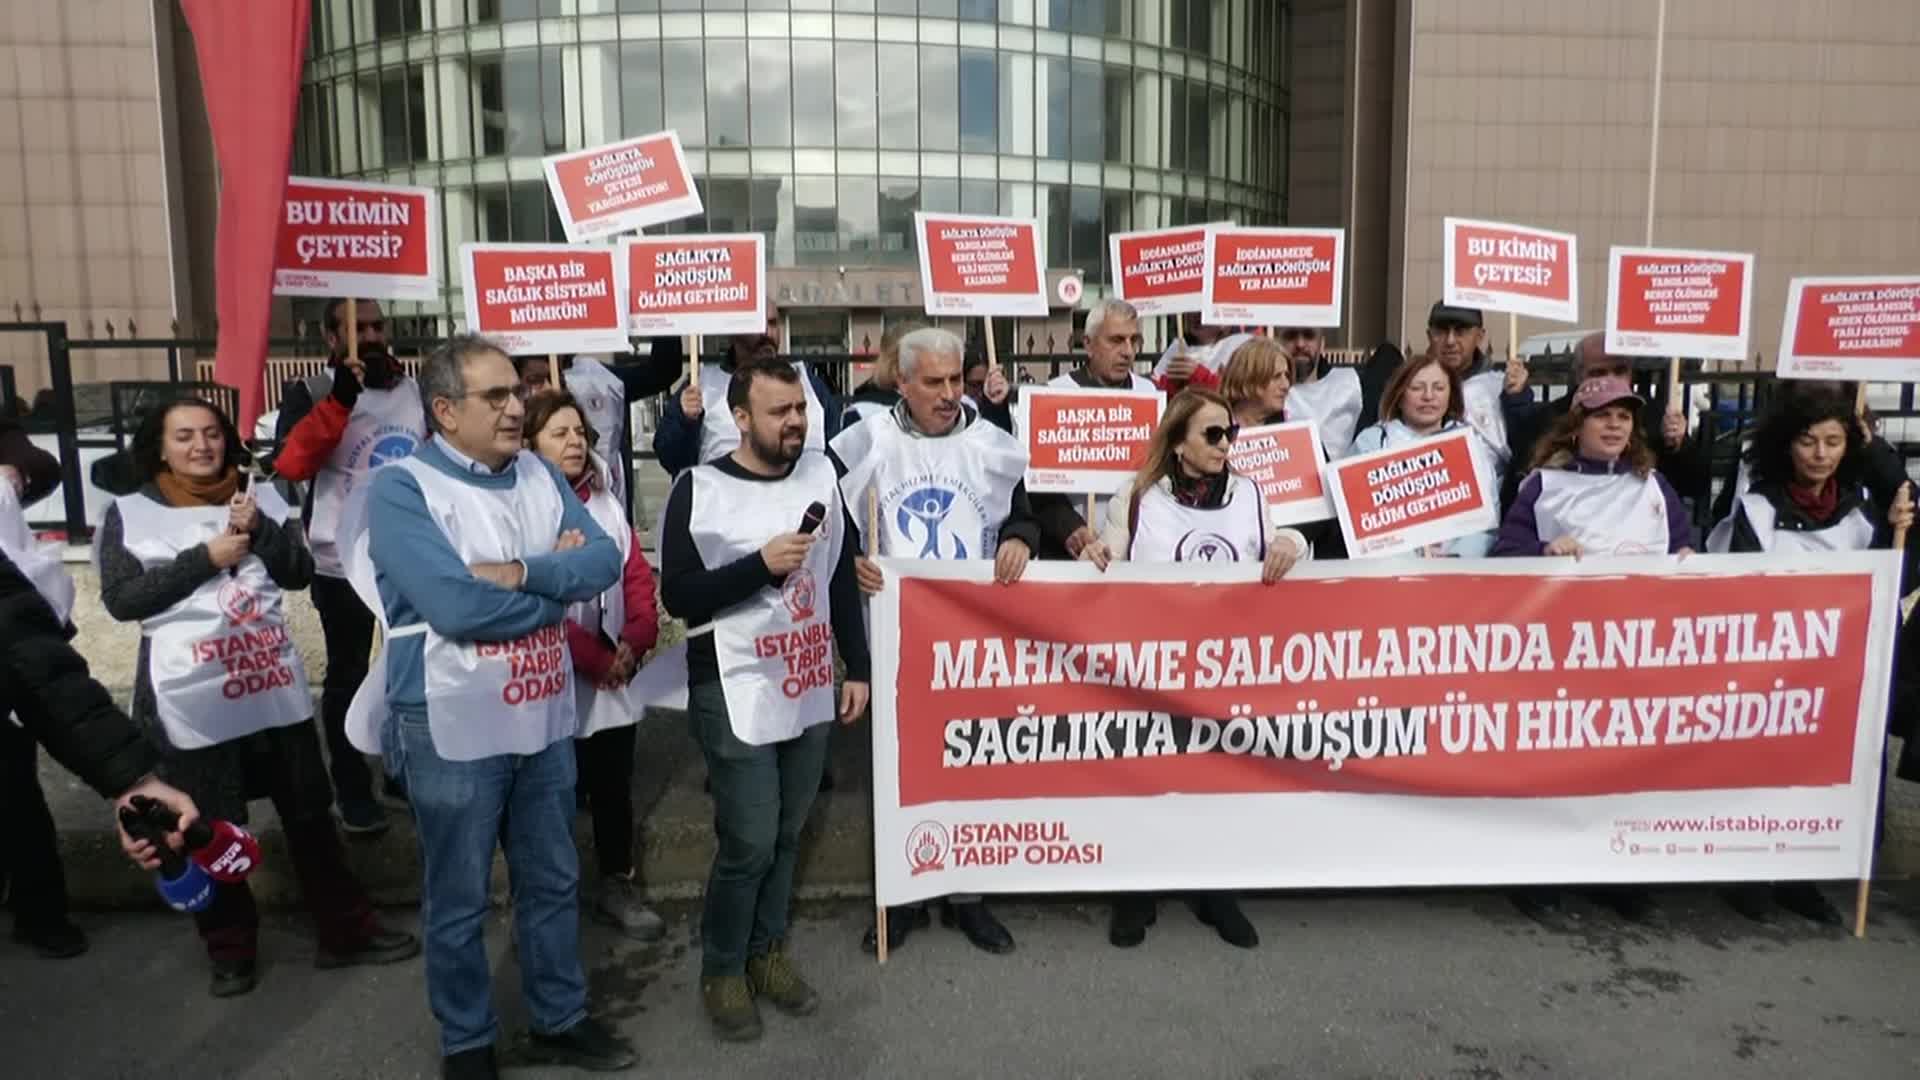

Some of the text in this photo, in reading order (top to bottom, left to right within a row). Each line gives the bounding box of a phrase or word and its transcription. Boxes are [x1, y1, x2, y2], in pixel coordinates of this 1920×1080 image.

[286, 196, 410, 225] BU KİMİN
[296, 229, 403, 264] ÇETESİ?
[655, 247, 731, 267] SAĞLIKTA
[1236, 245, 1314, 261] İDDİANAMEDE
[1467, 236, 1558, 263] BU KİMİN
[503, 260, 585, 285] BAŞKA BİR
[1175, 254, 1204, 268] DÖNÜ
[1217, 259, 1331, 277] SAĞLIKTA DÖNÜŞÜM
[655, 265, 732, 288] DÖNÜŞÜM
[1145, 267, 1204, 286] YER ALMAL
[1239, 278, 1261, 291] YER
[1474, 263, 1552, 287] ÇETESİ?
[485, 278, 607, 305] SAĞLIK SİSTEMİ
[638, 282, 749, 309] ÖLÜM GETİRDİ!
[510, 300, 588, 325] MÜMKÜN!
[1057, 404, 1132, 426] BAŞKA BİR
[1037, 423, 1150, 444] SAĞLIK SİSTEMİ
[1229, 434, 1278, 455] AĞLIKTA
[1058, 443, 1130, 463] MÜMKÜN!
[1367, 448, 1444, 486] SAĞLIKTA
[1371, 468, 1450, 507] DÖNÜŞÜM
[1360, 482, 1472, 531] ÖLÜM GETİRDİ!
[931, 608, 1841, 690] MAHKEME SALONLARINDA ANLATILAN
[223, 665, 294, 698] ODASI
[503, 672, 566, 705] ODASI
[943, 678, 1824, 770] SAĞLIKTA DÖNÜŞÜM'ÜN HİKAYESİDİR!
[1653, 814, 1843, 834] www.istabip.org.tr
[1024, 844, 1103, 865] ODASI
